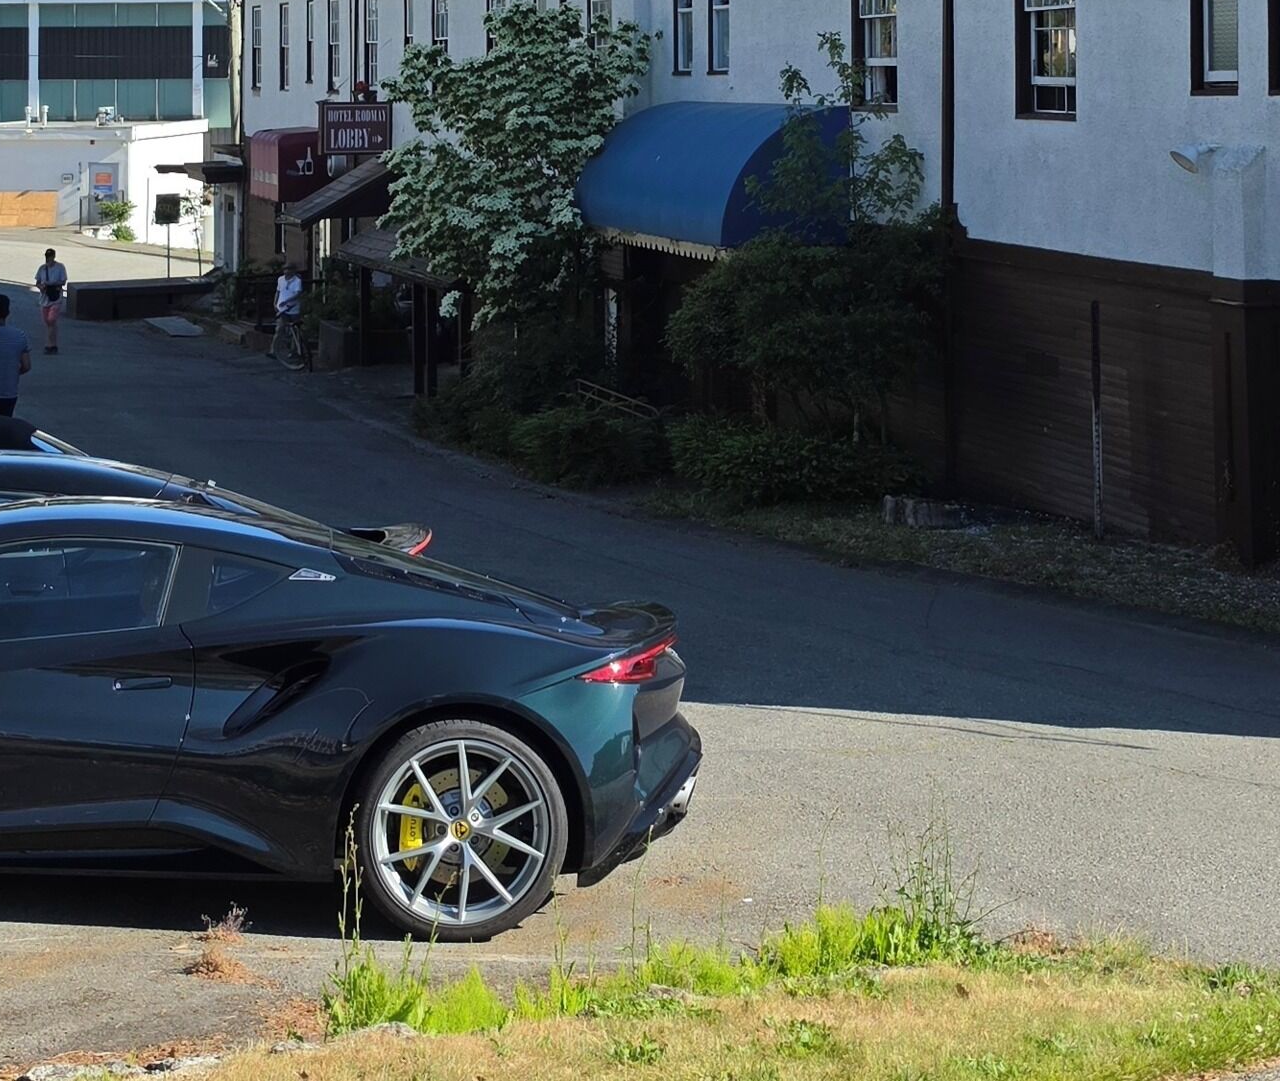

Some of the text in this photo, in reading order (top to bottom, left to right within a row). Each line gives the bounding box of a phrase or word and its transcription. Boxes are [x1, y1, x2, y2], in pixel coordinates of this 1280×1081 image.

[327, 110, 386, 122] HOTEL RODMAY
[330, 128, 371, 149] LOBBY
